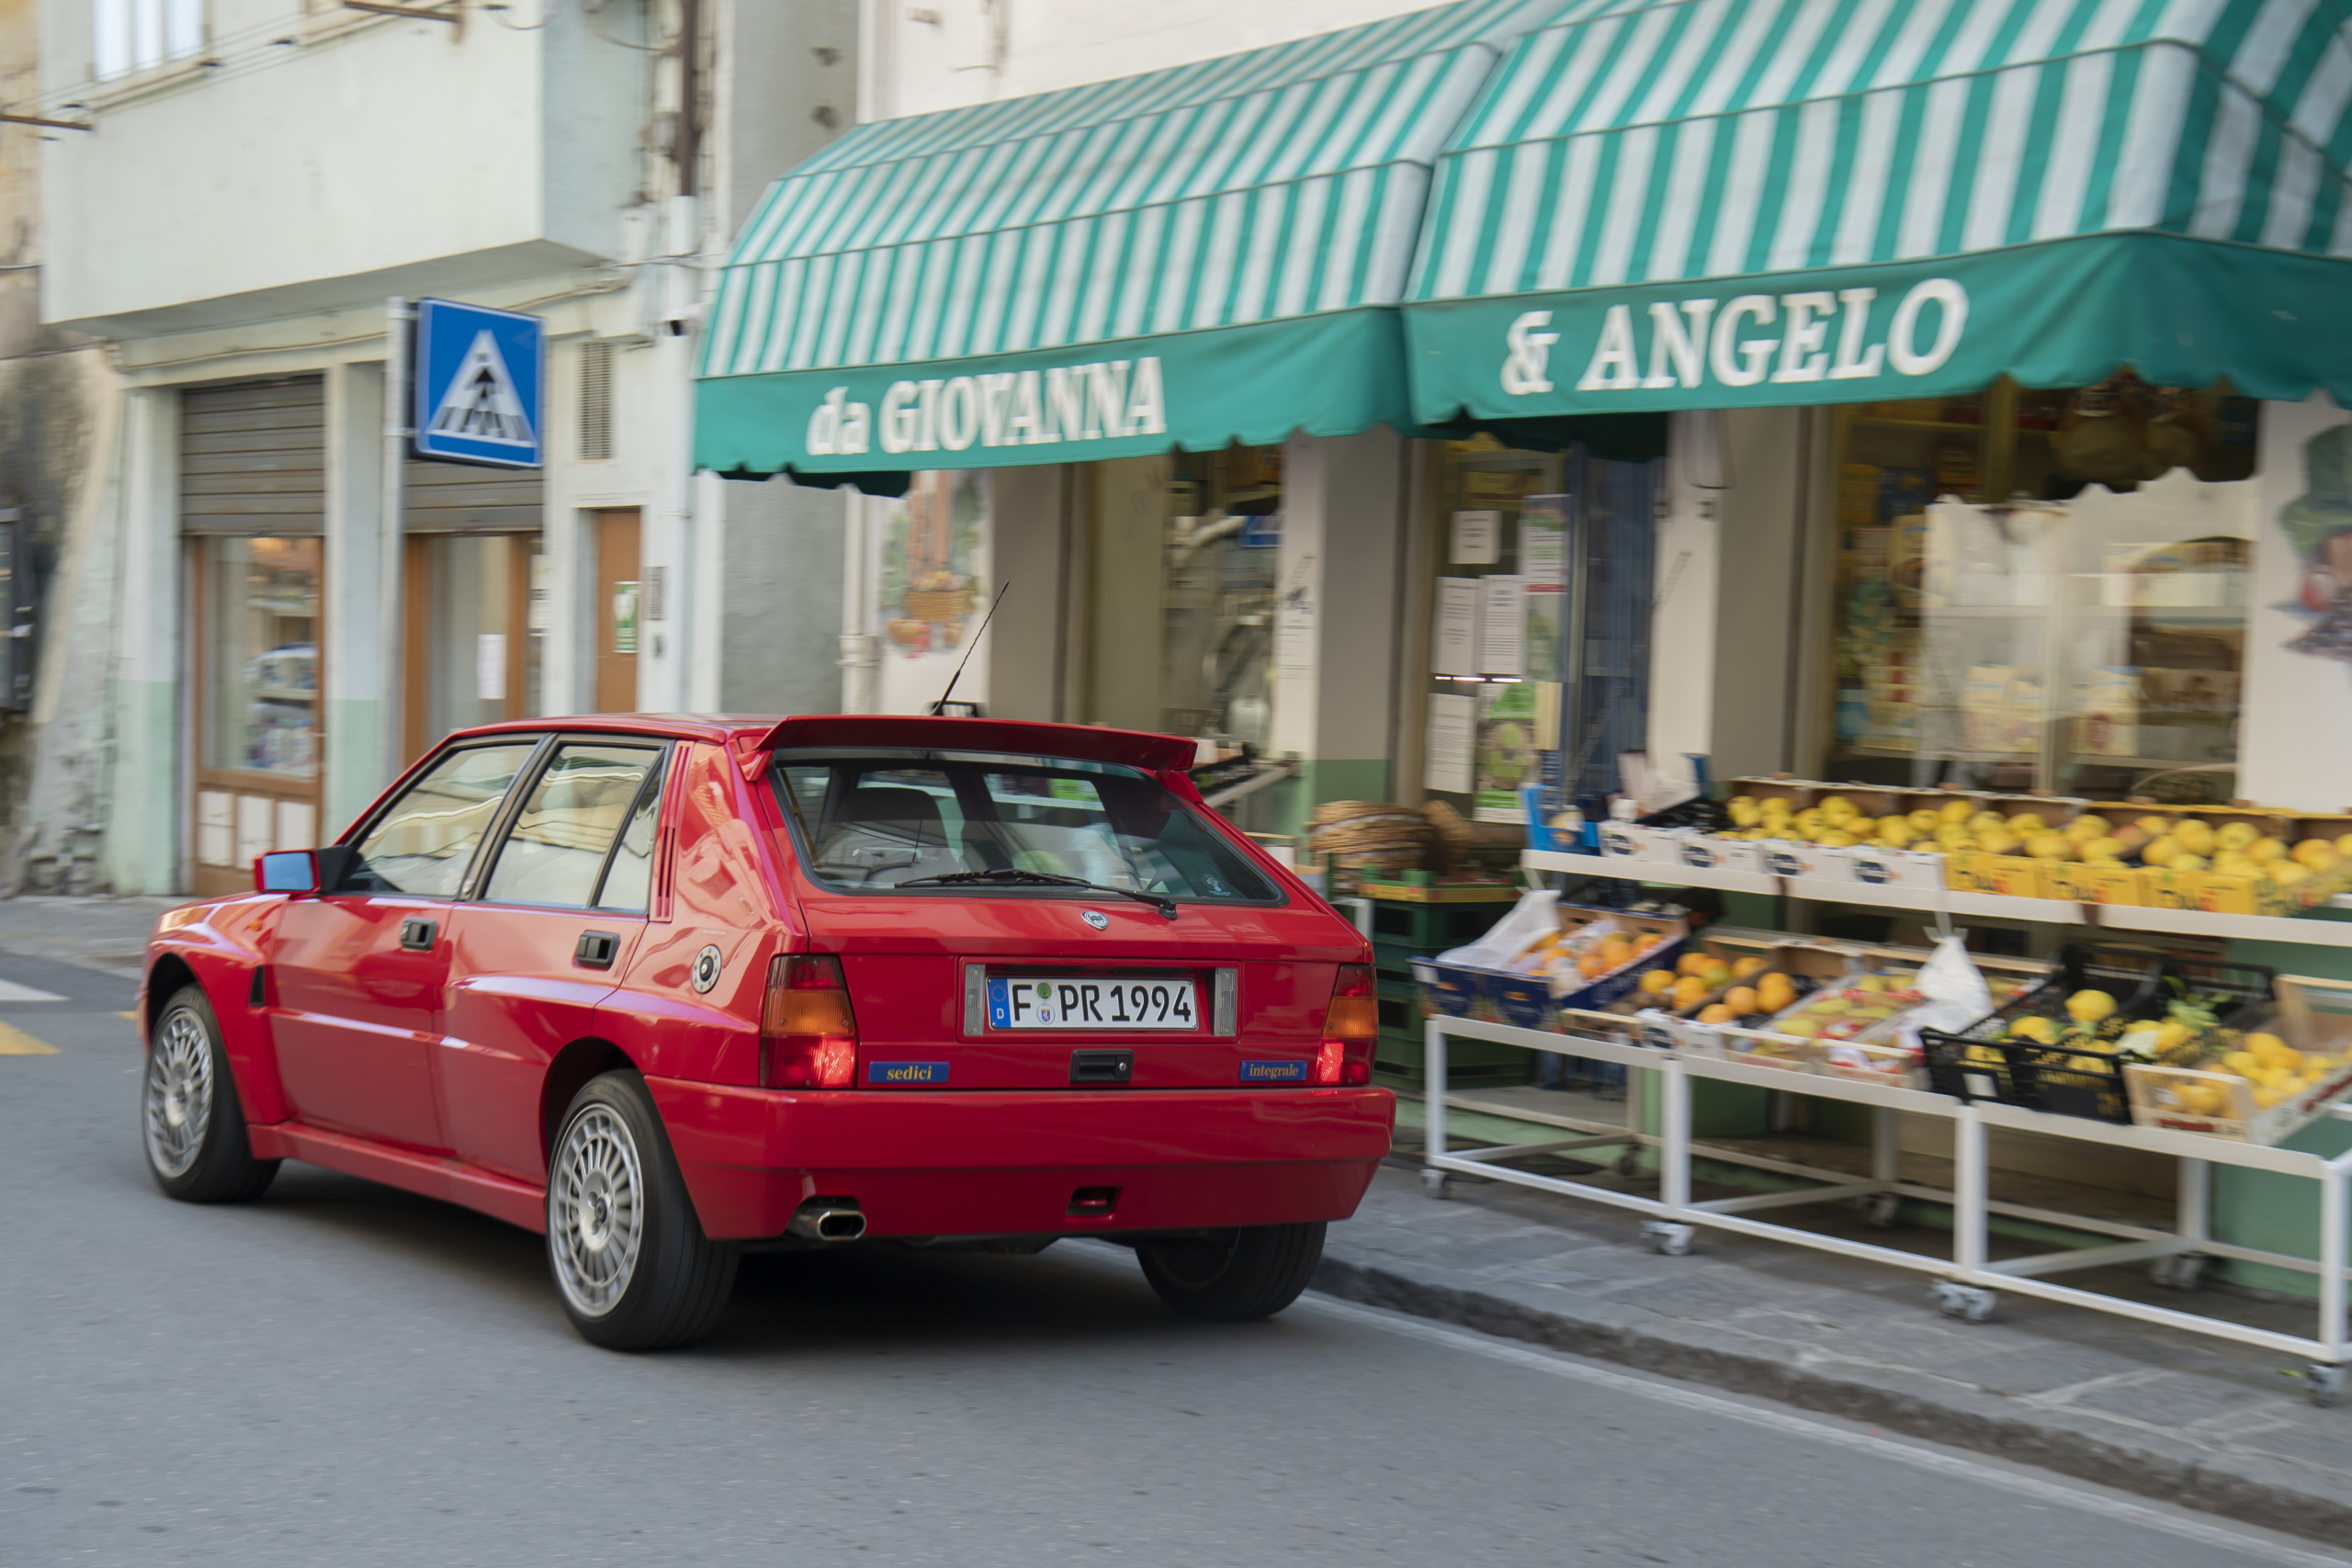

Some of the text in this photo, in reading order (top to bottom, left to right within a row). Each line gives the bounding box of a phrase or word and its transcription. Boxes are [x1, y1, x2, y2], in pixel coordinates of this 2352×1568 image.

[1500, 277, 1971, 396] & ANGELO
[805, 356, 1168, 456] da GIOVANNA
[996, 984, 1193, 1022] D F PR 1994
[887, 1066, 933, 1080] sedici
[1249, 1064, 1299, 1079] integrale
